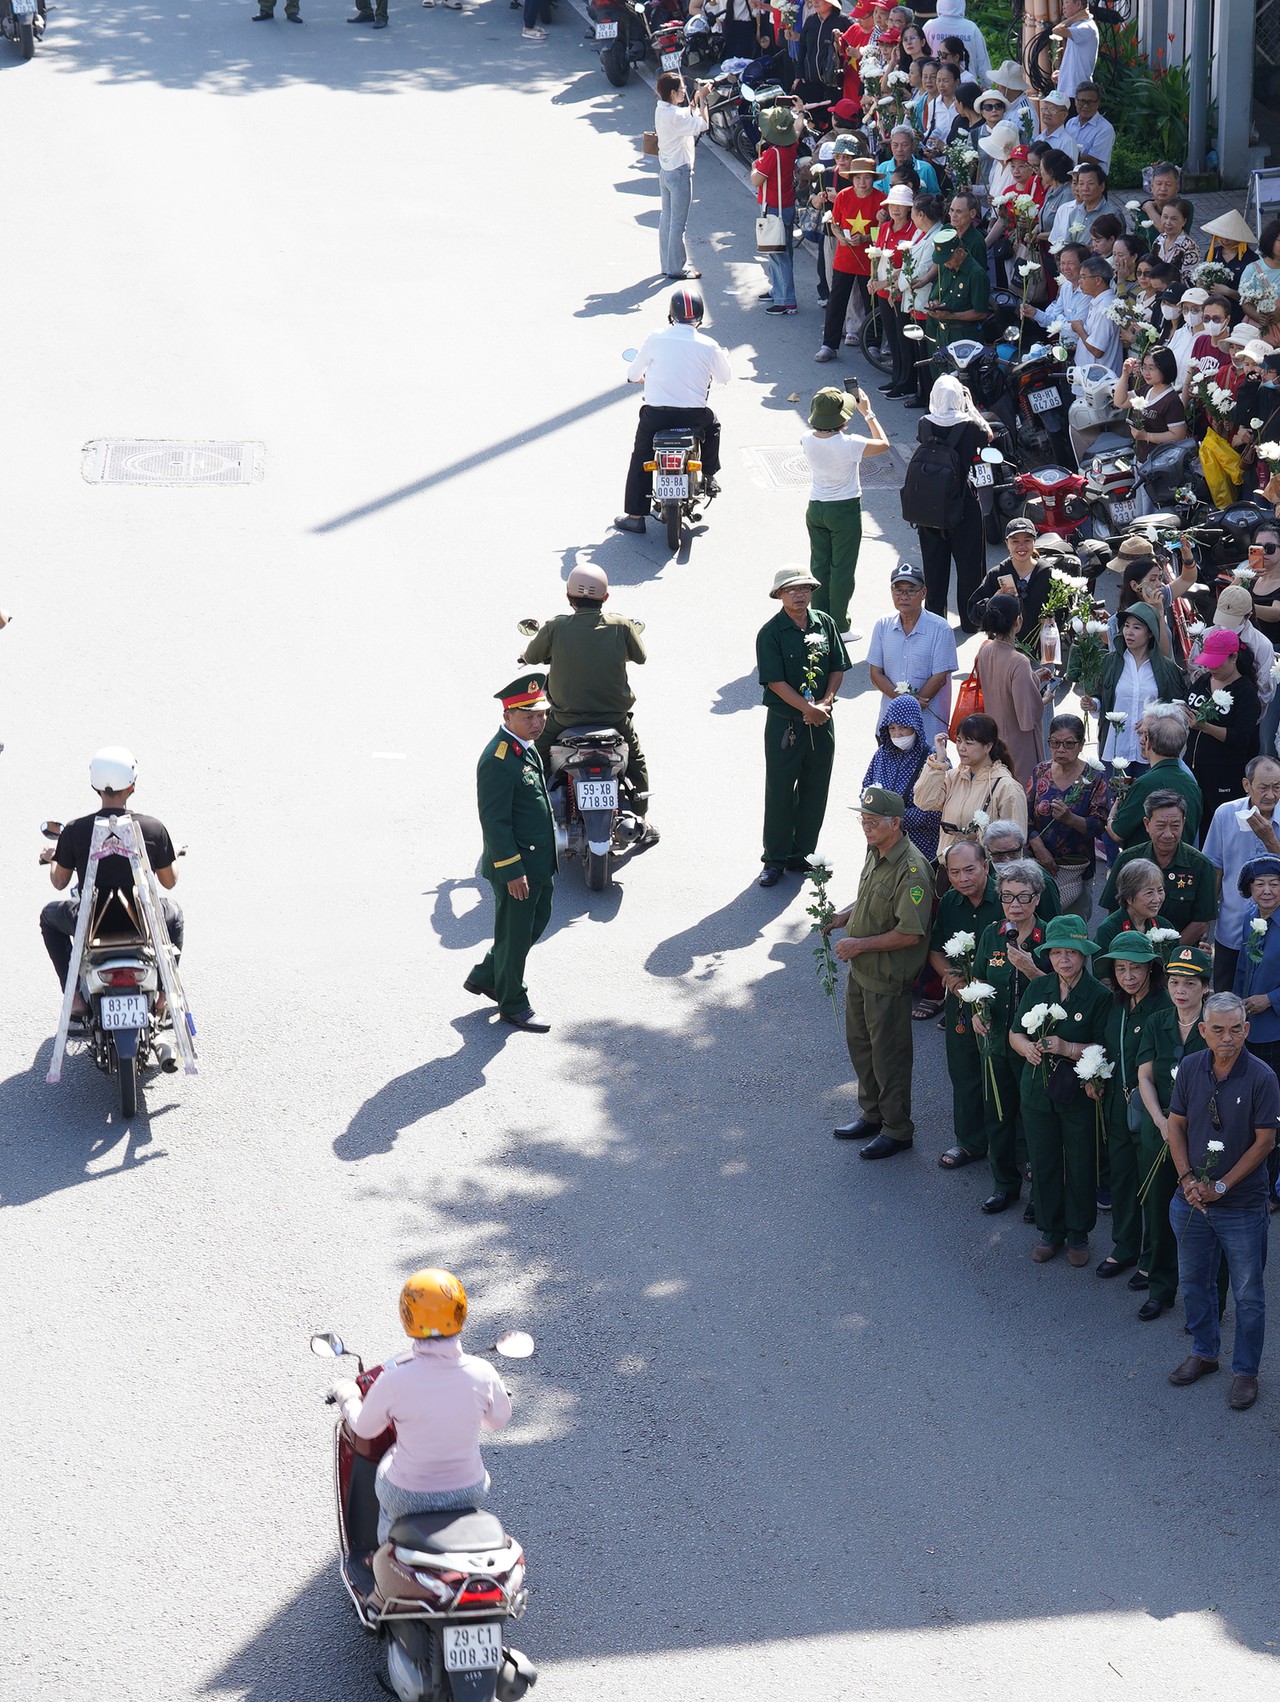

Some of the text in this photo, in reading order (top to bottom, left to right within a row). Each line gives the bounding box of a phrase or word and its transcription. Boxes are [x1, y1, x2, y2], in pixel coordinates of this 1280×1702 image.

[1033, 389, 1054, 402] 59-H1
[1033, 396, 1060, 412] 047.05
[661, 477, 684, 487] 59-BA
[658, 487, 687, 497] 009.06
[583, 783, 611, 795] 59-XB
[581, 795, 615, 808] 718.98
[108, 997, 139, 1011] 83-PT
[105, 1011, 146, 1027] 302.43
[453, 1626, 493, 1647] 29-C1
[449, 1646, 499, 1668] 908.38
